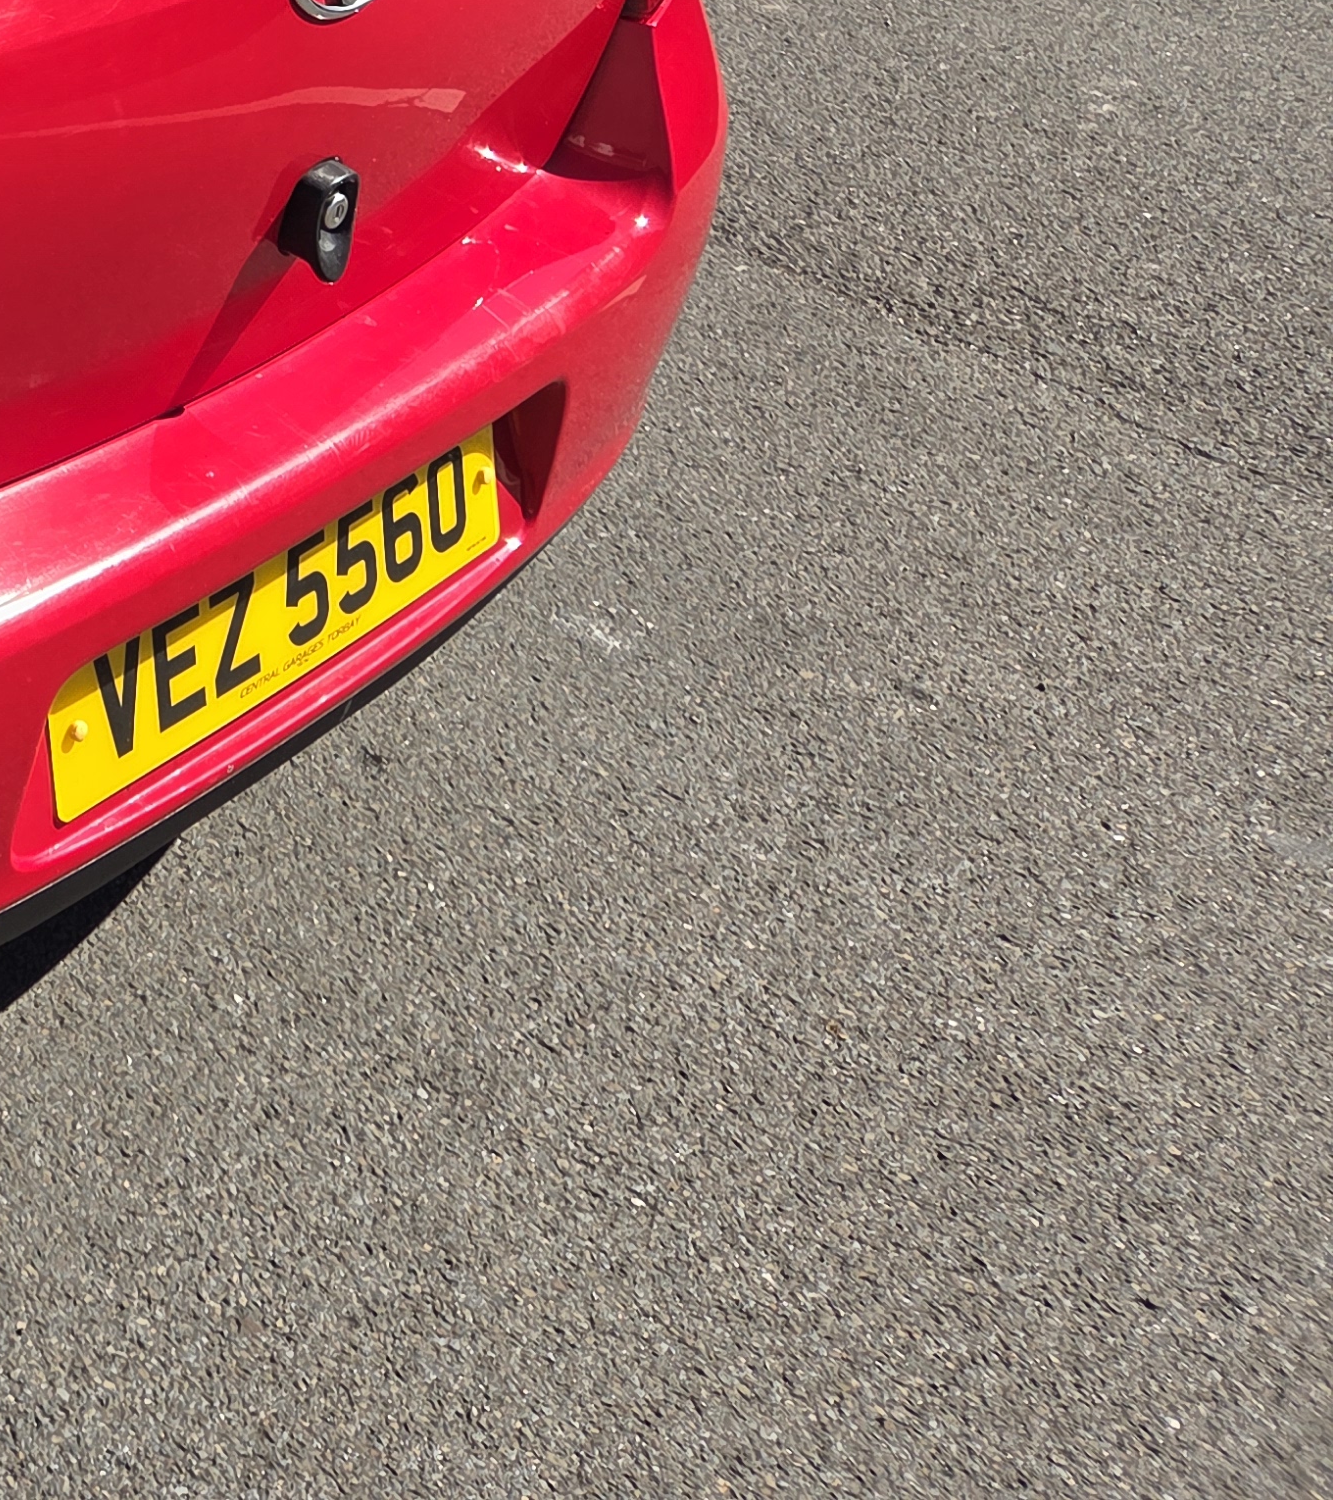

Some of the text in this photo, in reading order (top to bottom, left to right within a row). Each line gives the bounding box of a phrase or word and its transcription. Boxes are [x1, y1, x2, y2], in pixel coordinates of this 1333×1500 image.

[93, 445, 467, 759] VEZ 5560
[239, 615, 362, 699] CENTRAL GARAGES TORBAY
